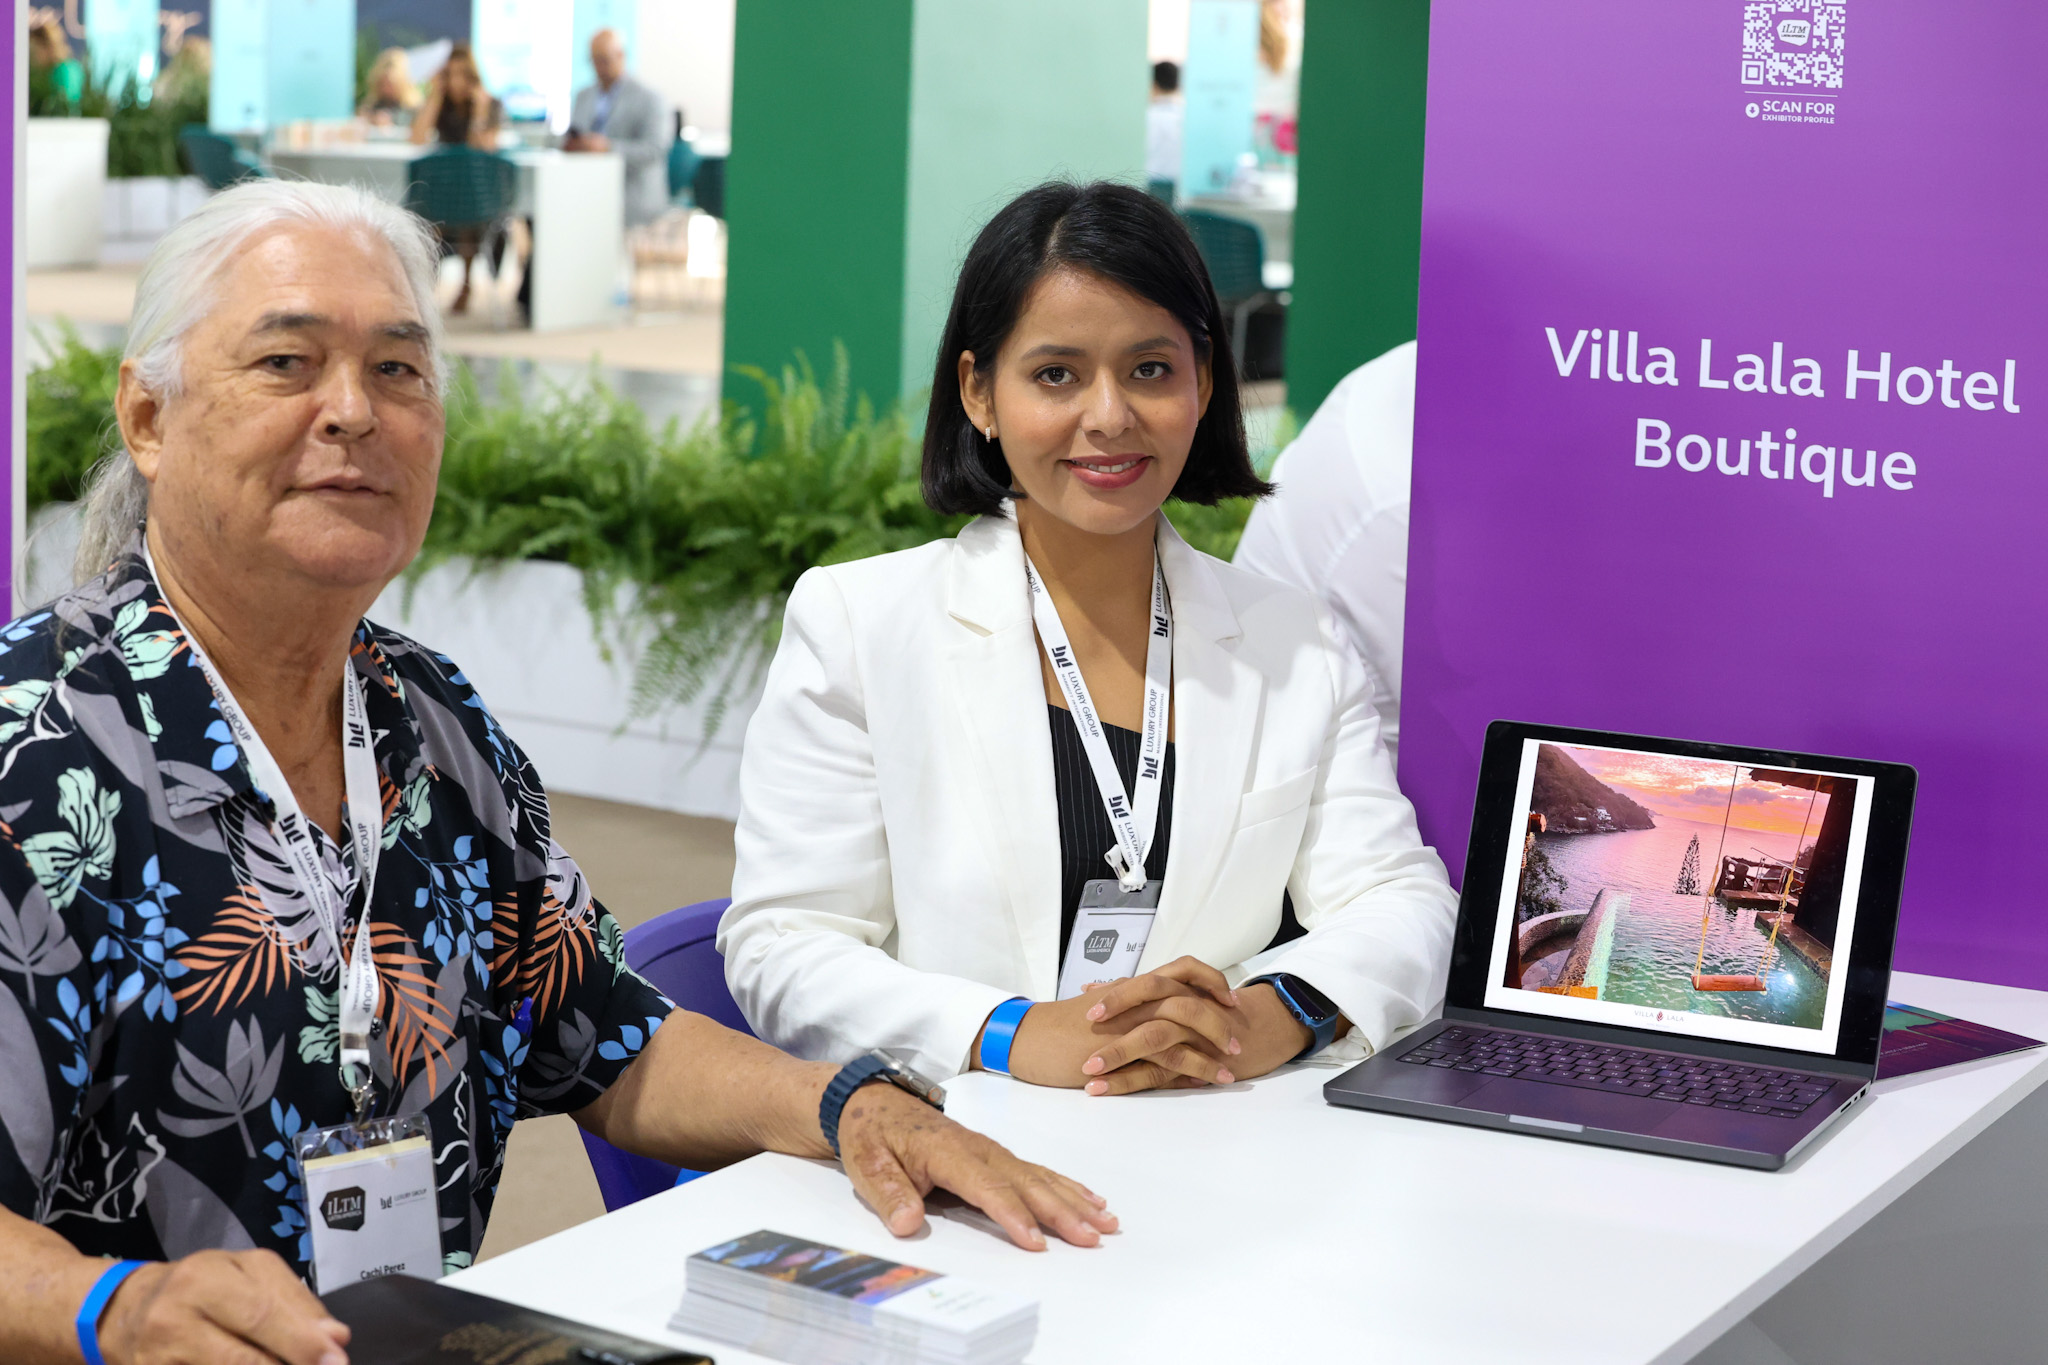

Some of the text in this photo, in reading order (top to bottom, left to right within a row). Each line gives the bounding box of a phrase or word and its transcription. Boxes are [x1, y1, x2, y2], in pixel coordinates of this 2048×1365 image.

[1762, 100, 1835, 115] SCAN FOR
[1762, 114, 1835, 125] EXHIBITOR PROFILE
[1545, 326, 2021, 414] Villa Lala Hotel
[1634, 417, 1918, 499] Boutique
[223, 705, 252, 741] GROUP
[1068, 671, 1100, 738] LUXURY GROUP
[1146, 719, 1156, 753] LUXURY
[301, 845, 322, 888] LUXURY
[362, 975, 374, 1013] GROUP
[1634, 1010, 1654, 1018] VILLA
